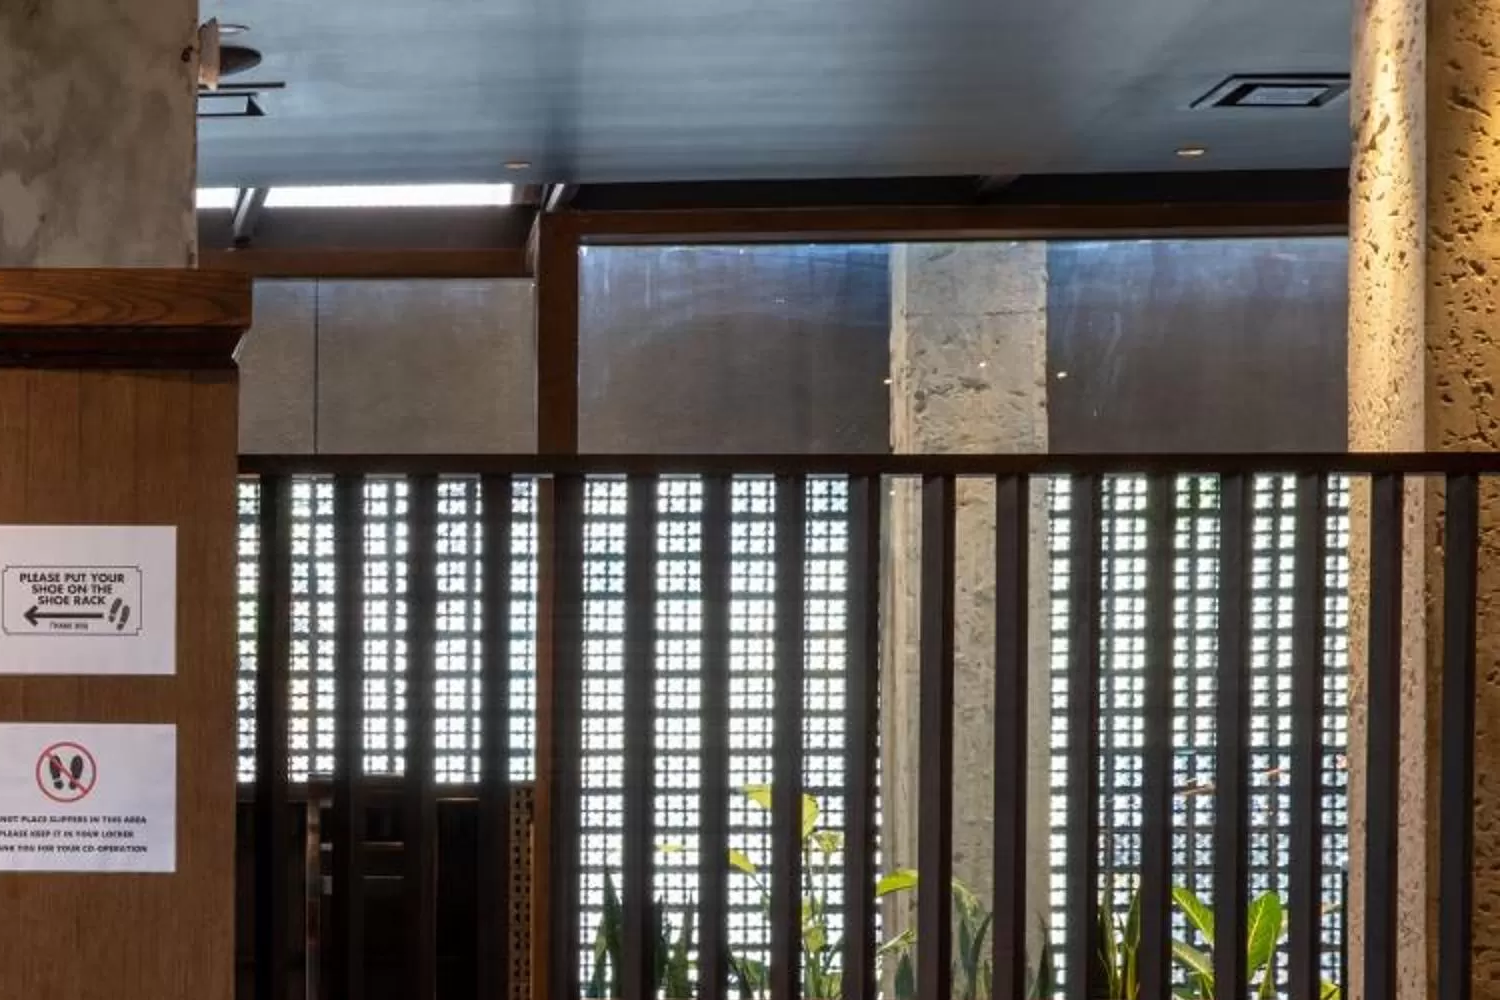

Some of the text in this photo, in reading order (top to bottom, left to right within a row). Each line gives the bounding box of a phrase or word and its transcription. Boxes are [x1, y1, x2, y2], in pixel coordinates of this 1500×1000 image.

[19, 573, 125, 583] PLEASE PUT YOUR
[31, 584, 113, 594] SHOE ON THE
[37, 595, 106, 605] SHOE RACK
[0, 815, 18, 823] NOT
[21, 815, 47, 823] PLACE
